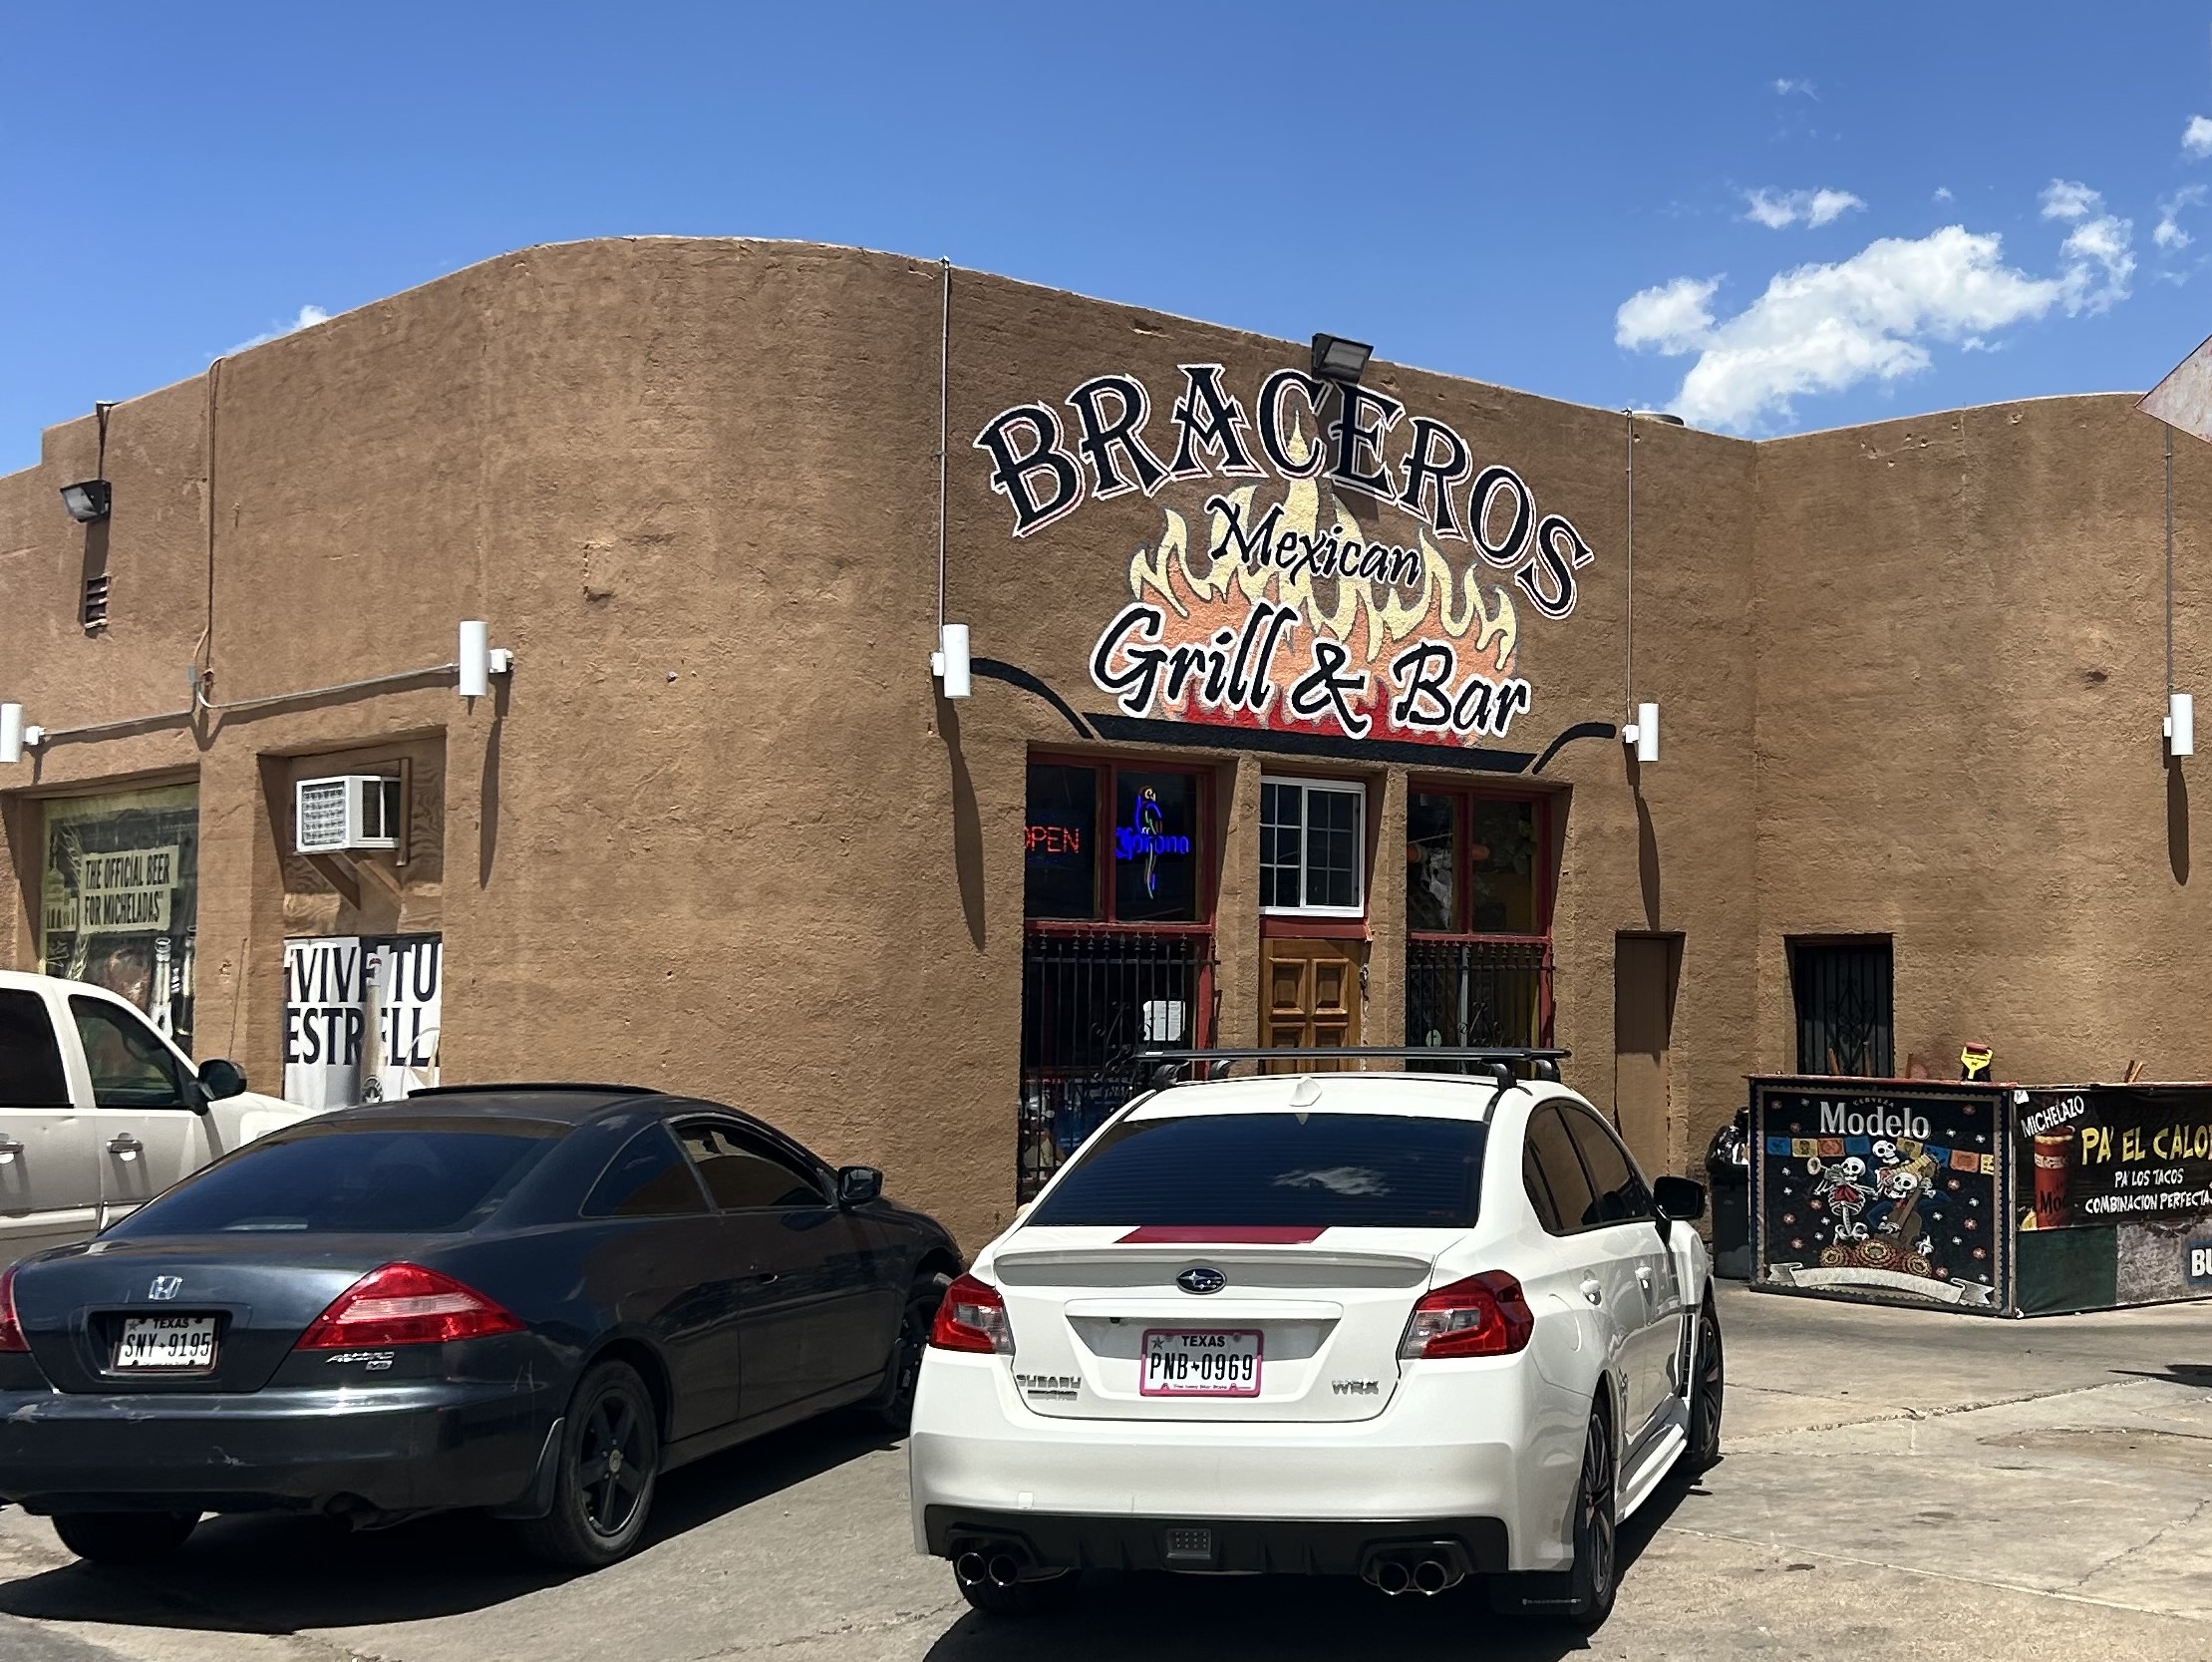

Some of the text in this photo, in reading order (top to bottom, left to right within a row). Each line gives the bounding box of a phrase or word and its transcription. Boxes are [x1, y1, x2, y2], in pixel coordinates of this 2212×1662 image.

[974, 365, 1593, 617] BRACEROS
[1207, 497, 1423, 586] Mexican
[1091, 602, 1530, 739] Grill & Bar
[86, 852, 170, 889] THE OFFICIAL BEER
[85, 894, 101, 925] FOR
[390, 941, 439, 1002] TU
[283, 1007, 440, 1067] ESTRLL
[1819, 1101, 1931, 1140] Modelo
[1852, 1097, 1895, 1108] CERVEZA
[2021, 1096, 2084, 1139] MICHELAZO
[2122, 1127, 2146, 1163] EL
[2152, 1124, 2212, 1161] CALO
[2131, 1169, 2151, 1186] LOS
[2153, 1167, 2184, 1185] TACOS
[2084, 1194, 2157, 1214] COMBINACION
[153, 1318, 189, 1329] TEXAS
[1181, 1336, 1225, 1347] TEXAS
[1016, 1375, 1082, 1388] SUBARU
[1332, 1380, 1380, 1395] WRX
